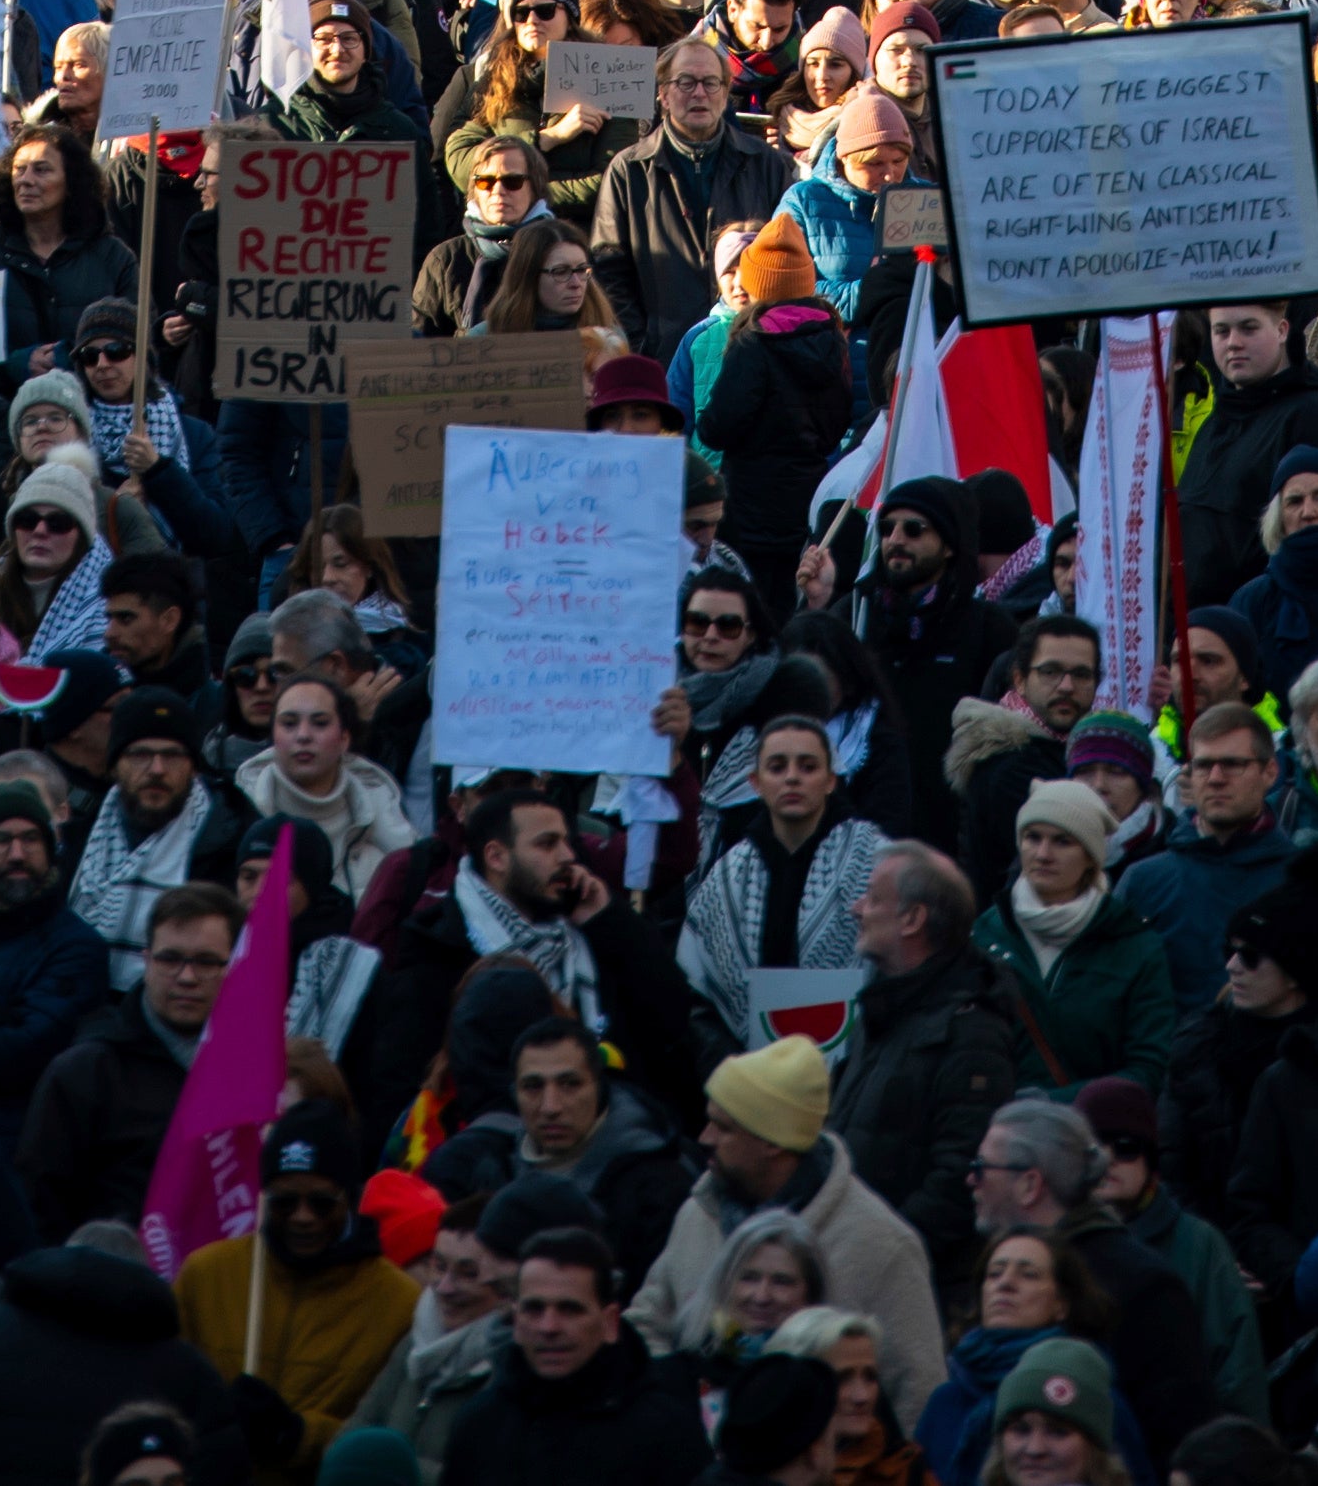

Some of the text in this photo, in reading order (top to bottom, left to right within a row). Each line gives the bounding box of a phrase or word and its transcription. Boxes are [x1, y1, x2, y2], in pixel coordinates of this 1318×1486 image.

[112, 39, 205, 78] EMPATHIE
[562, 52, 600, 76] Nie
[973, 71, 1272, 115] TODAY THE BIGGEST
[969, 113, 1261, 159] SUPPORTERS OF ISRAEL
[233, 148, 411, 202] STOPPT
[981, 161, 1279, 204] ARE OFTEN CLASSICAL
[299, 197, 370, 239] DIE
[985, 208, 1135, 241] RIGHT-WING
[237, 226, 393, 276] RECHTE
[225, 277, 402, 324] REGIERUNG
[308, 323, 339, 357] IN
[233, 339, 348, 398] ISRA
